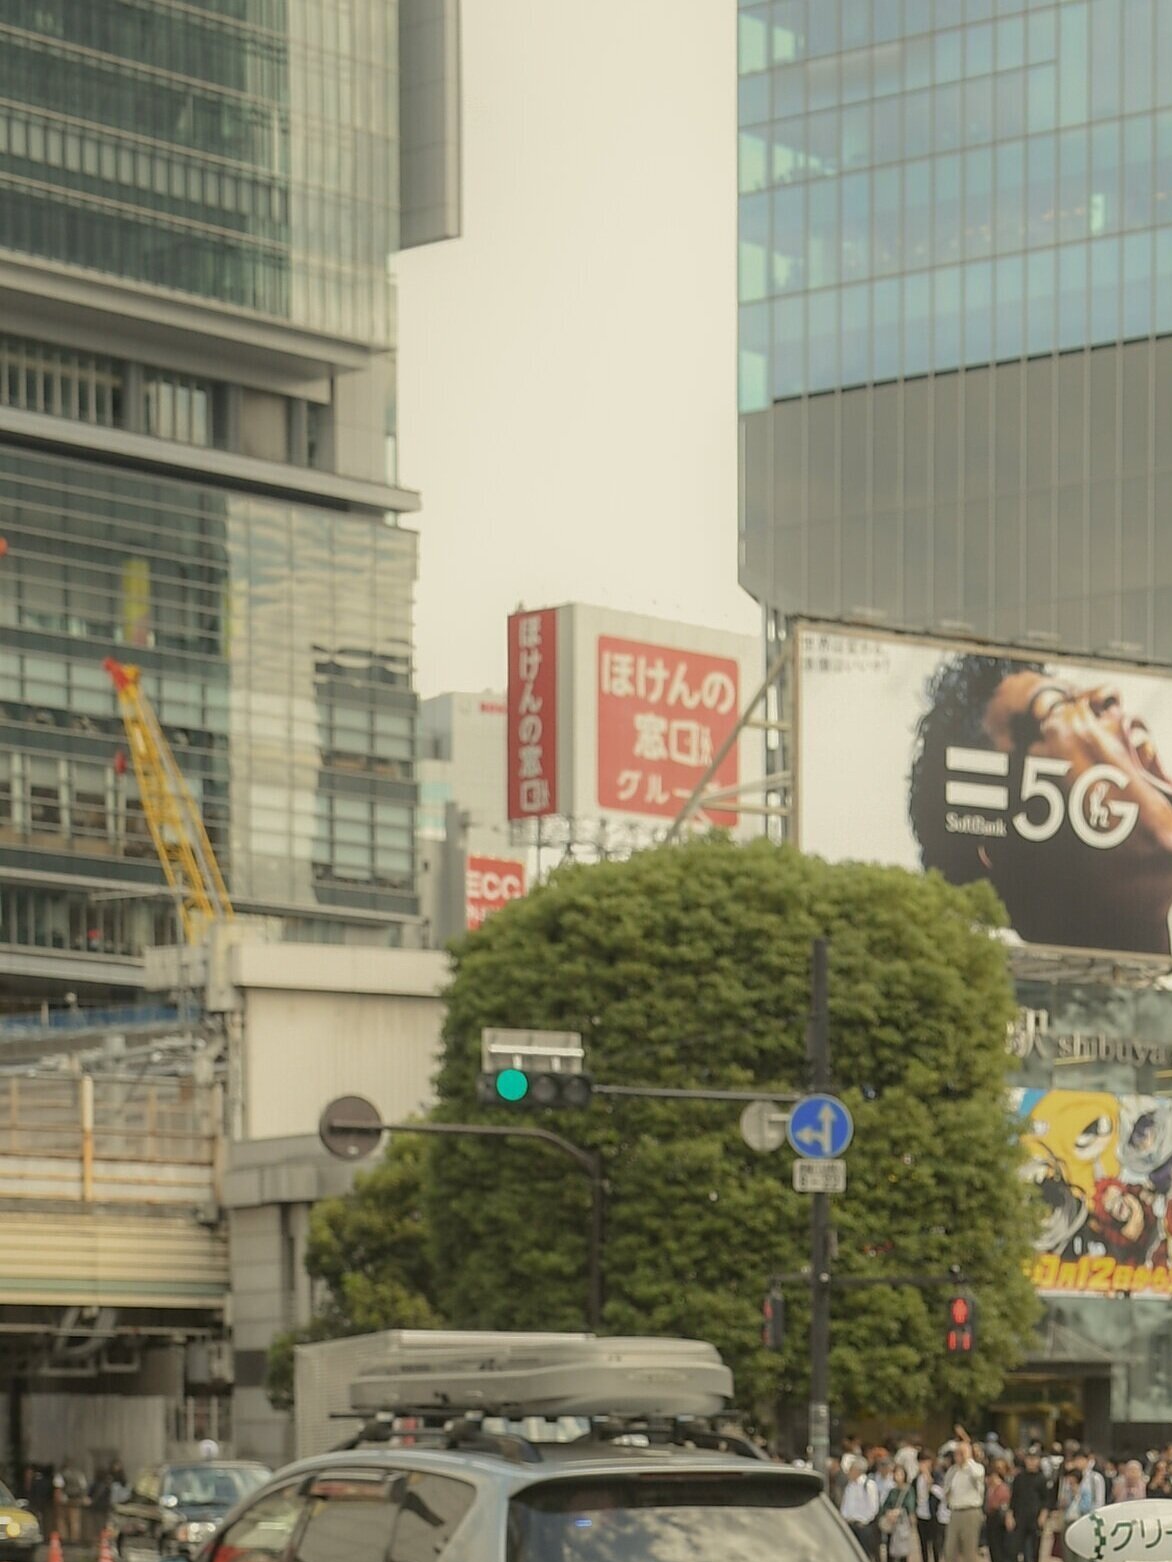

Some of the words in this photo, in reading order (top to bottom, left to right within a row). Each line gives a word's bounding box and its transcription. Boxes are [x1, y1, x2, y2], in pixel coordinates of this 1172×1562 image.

[601, 650, 736, 714] ほけんの
[517, 615, 550, 813] ほけんの窓口
[633, 712, 714, 767] 窓口
[945, 811, 1008, 838] SoftBank
[1013, 755, 1140, 850] 5G
[1058, 1031, 1168, 1068] shibuya
